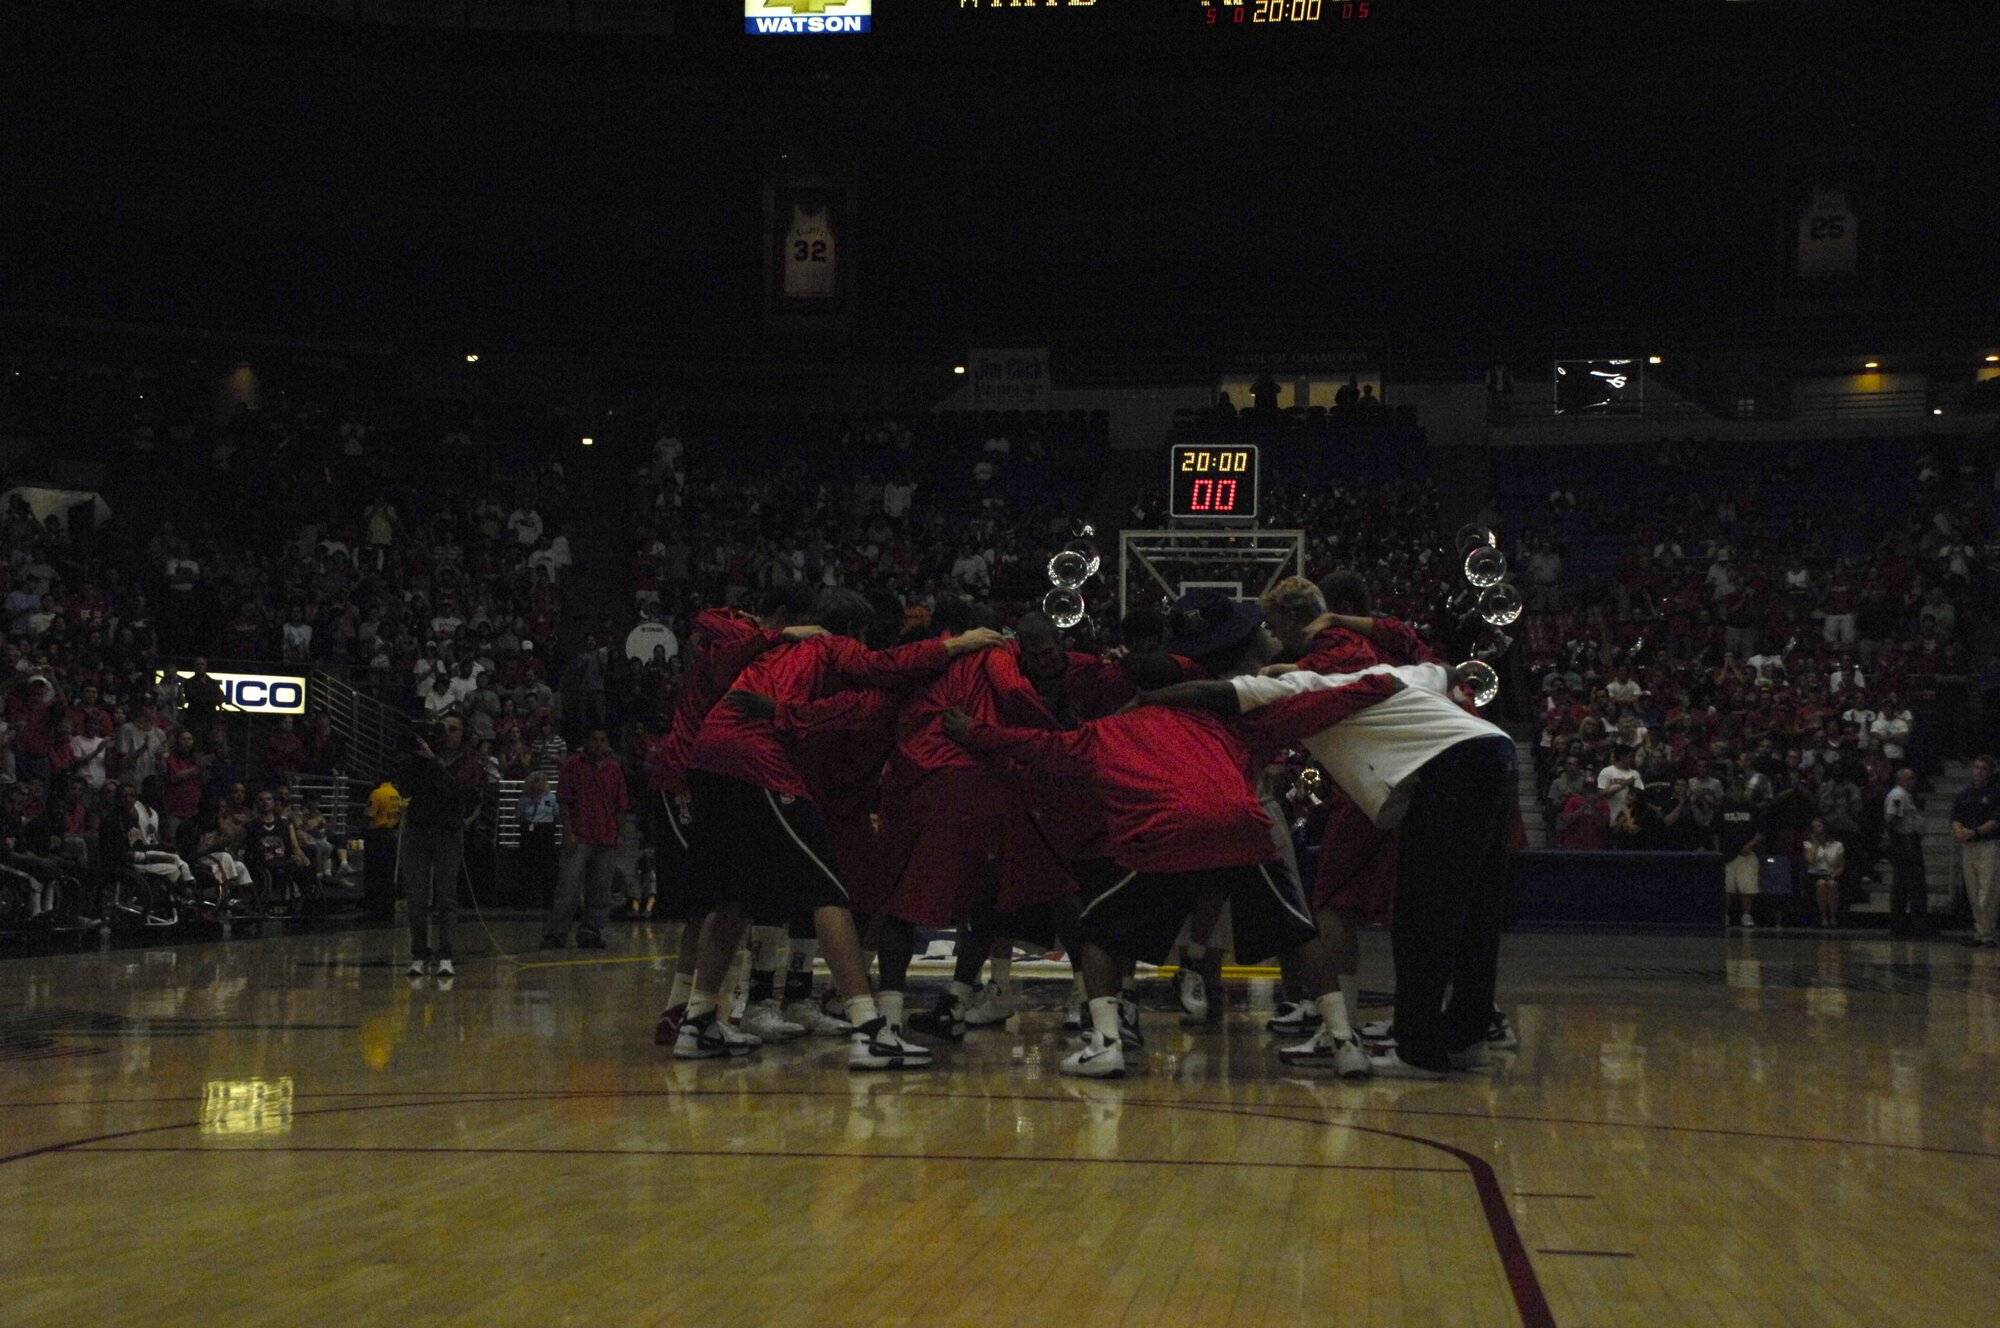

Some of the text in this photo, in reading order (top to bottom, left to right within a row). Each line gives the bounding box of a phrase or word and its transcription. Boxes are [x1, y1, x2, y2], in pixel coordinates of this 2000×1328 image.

[1253, 0, 1322, 23] 20:00
[756, 16, 861, 33] WATSON
[1810, 214, 1846, 241] 25
[794, 239, 827, 262] 32
[1181, 452, 1248, 472] 20:00
[1190, 478, 1238, 511] 00
[220, 680, 303, 708] ICO
